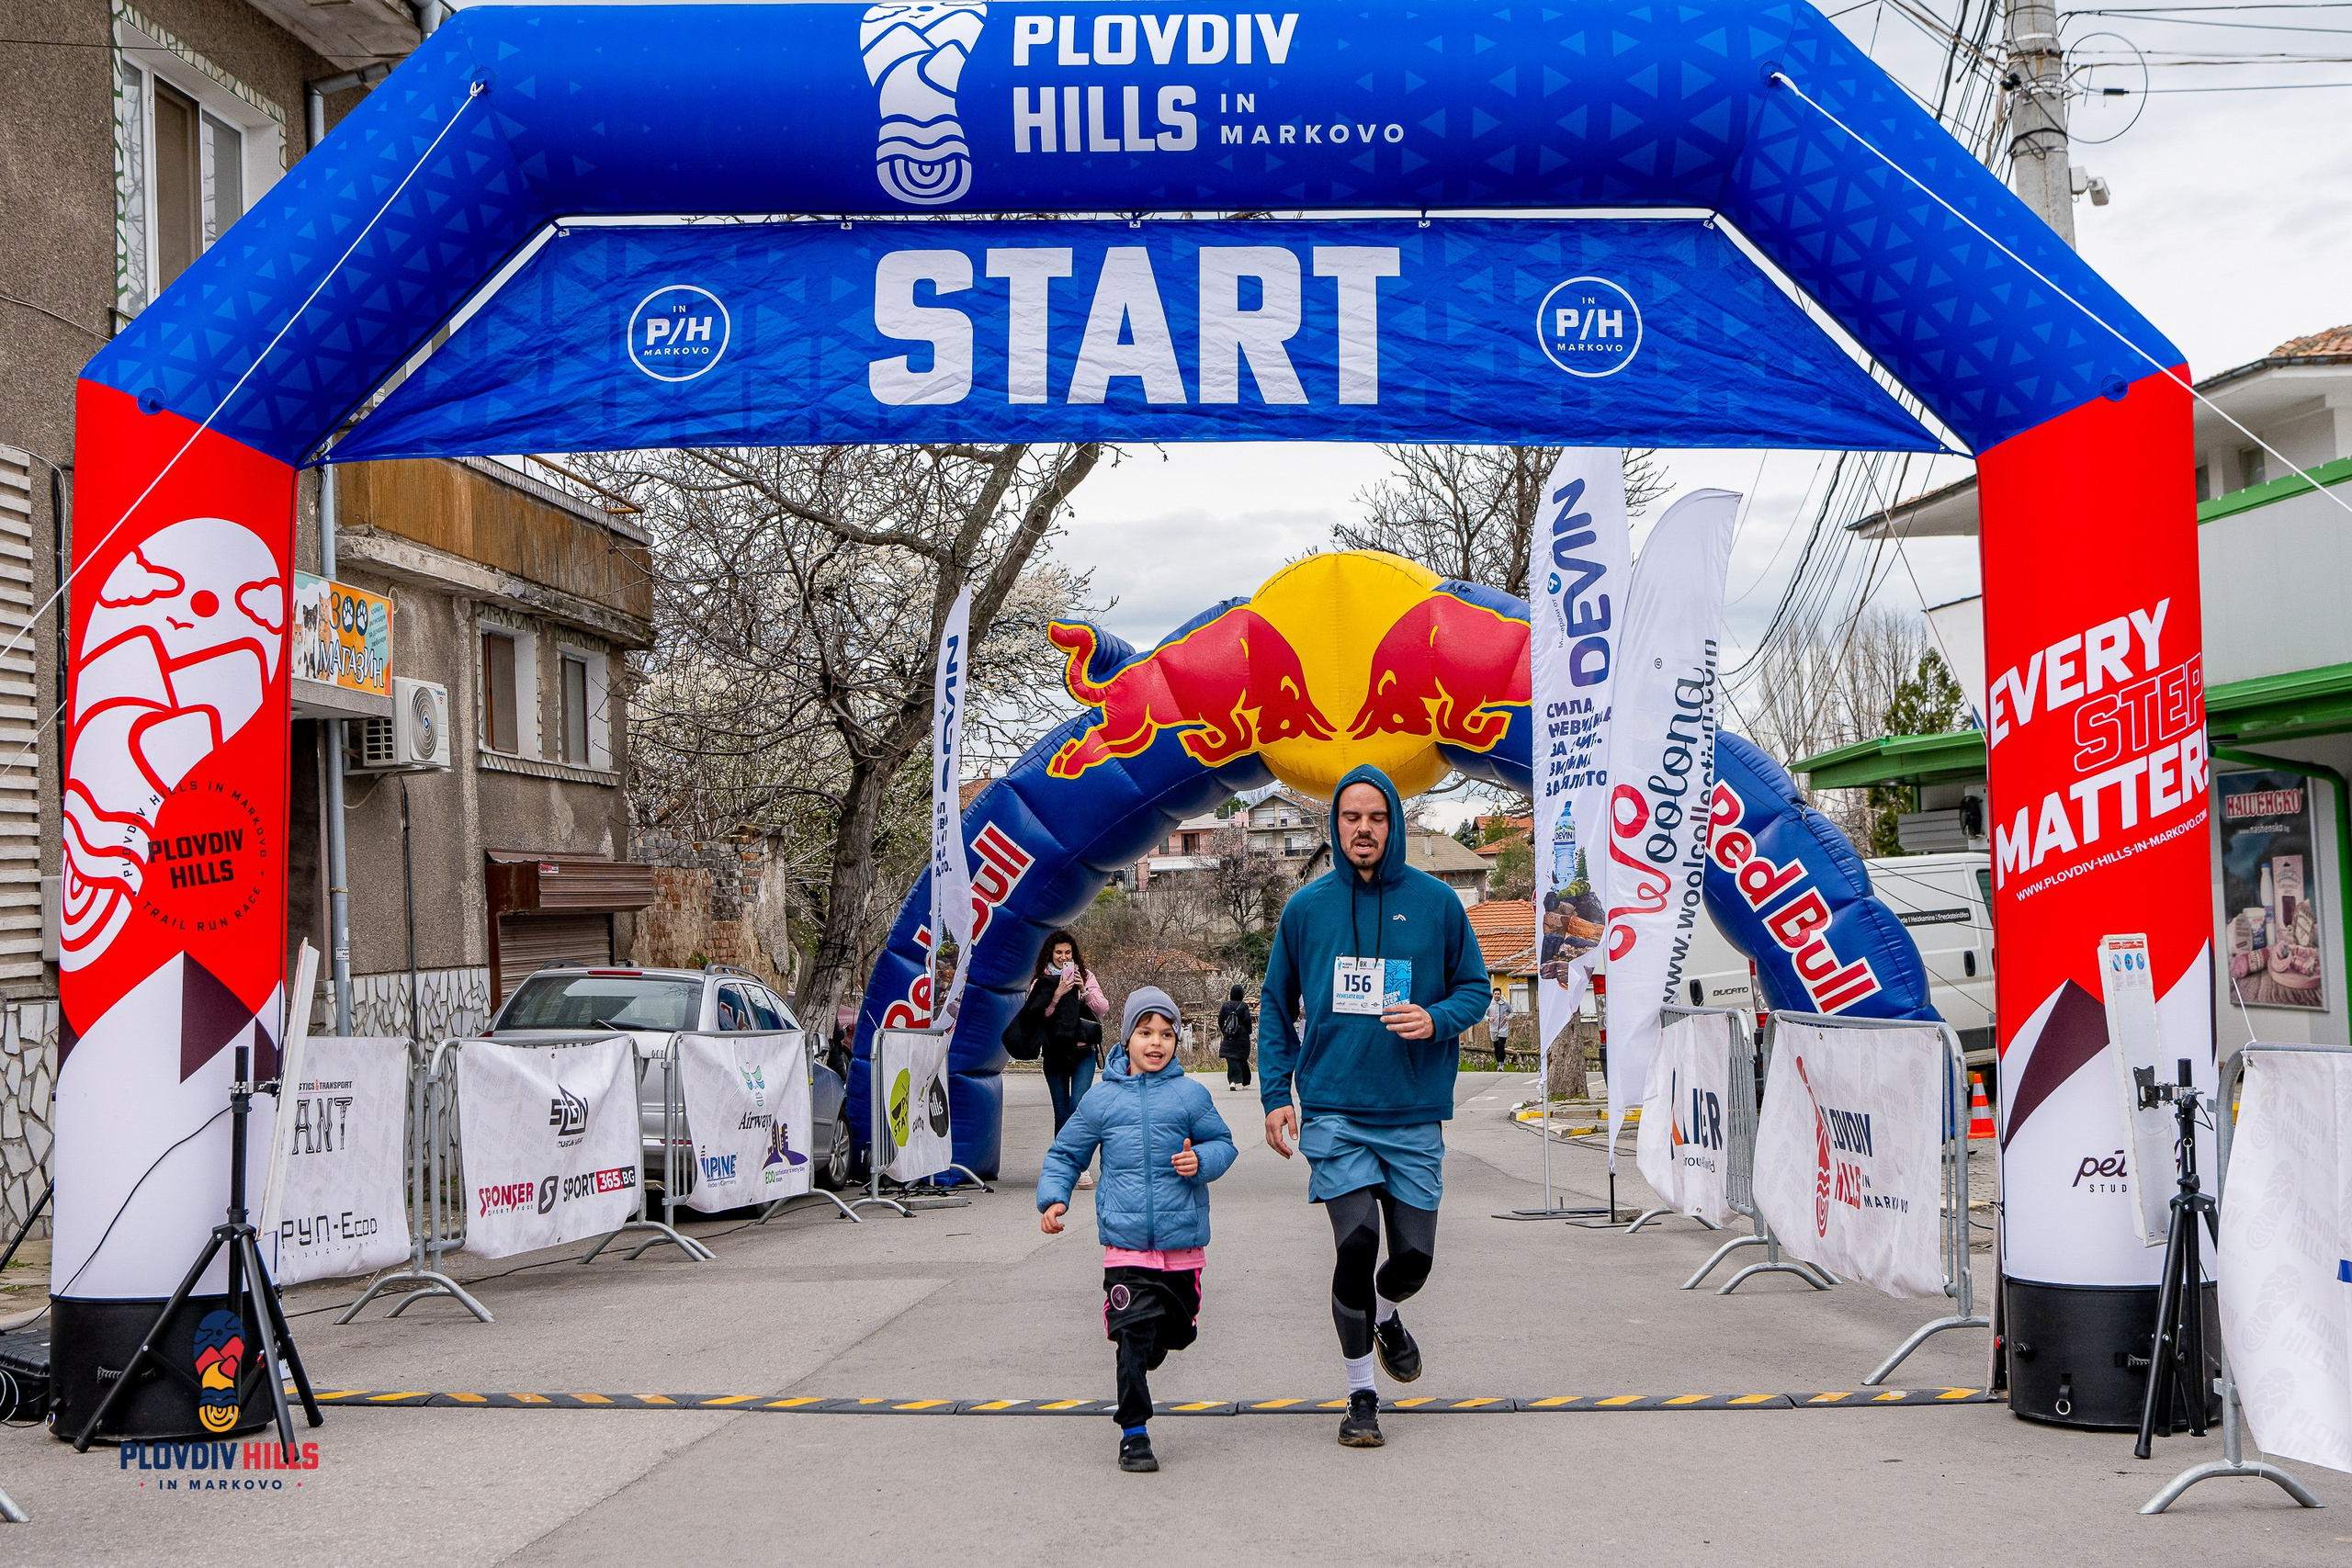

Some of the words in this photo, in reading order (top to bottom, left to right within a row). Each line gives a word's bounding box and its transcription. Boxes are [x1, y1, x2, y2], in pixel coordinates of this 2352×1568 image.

[1012, 13, 1299, 67] PLOVDIV
[1220, 94, 1257, 113] IN
[1012, 86, 1197, 153] HILLS
[1220, 123, 1405, 144] MARKOVO
[673, 305, 686, 313] IN
[646, 316, 713, 346] P/H
[868, 246, 1400, 406] START
[1555, 308, 1623, 341] P/H
[643, 346, 709, 356] MARKOVO
[1556, 343, 1623, 352] MARKOVO
[1553, 478, 1611, 688] DEVIN
[319, 638, 385, 689] МАГАЗИН
[1989, 597, 2170, 750] EVERY
[2074, 652, 2204, 773] STEP
[1560, 770, 1608, 790] ЯЛОТО
[2226, 788, 2302, 818] НАШЕНСКО
[121, 807, 146, 878] PLOVDIV
[149, 780, 198, 807] HILLS
[208, 781, 224, 794] IN
[231, 790, 266, 858] MARKOVO
[147, 829, 243, 863] PLOVDIV
[2016, 807, 2208, 902] WWW.PLOVDIV-HILLS-IN-MARKOVO.COM
[169, 859, 234, 889] HILLS
[142, 901, 187, 931] TRAIL
[197, 917, 229, 931] RUN
[234, 886, 261, 919] RACE
[1706, 781, 1805, 909] Red
[1765, 888, 1879, 1015] Bull
[884, 924, 932, 1030] Re
[1343, 974, 1372, 993] 156
[1713, 987, 1749, 997] DUCATO
[319, 1080, 354, 1090] TRANSPORT
[292, 1096, 354, 1156] ANT
[738, 1111, 773, 1132] Airways
[563, 1172, 596, 1202] SPORT
[1862, 1174, 1871, 1189] IN
[2089, 1183, 2128, 1193] STUD
